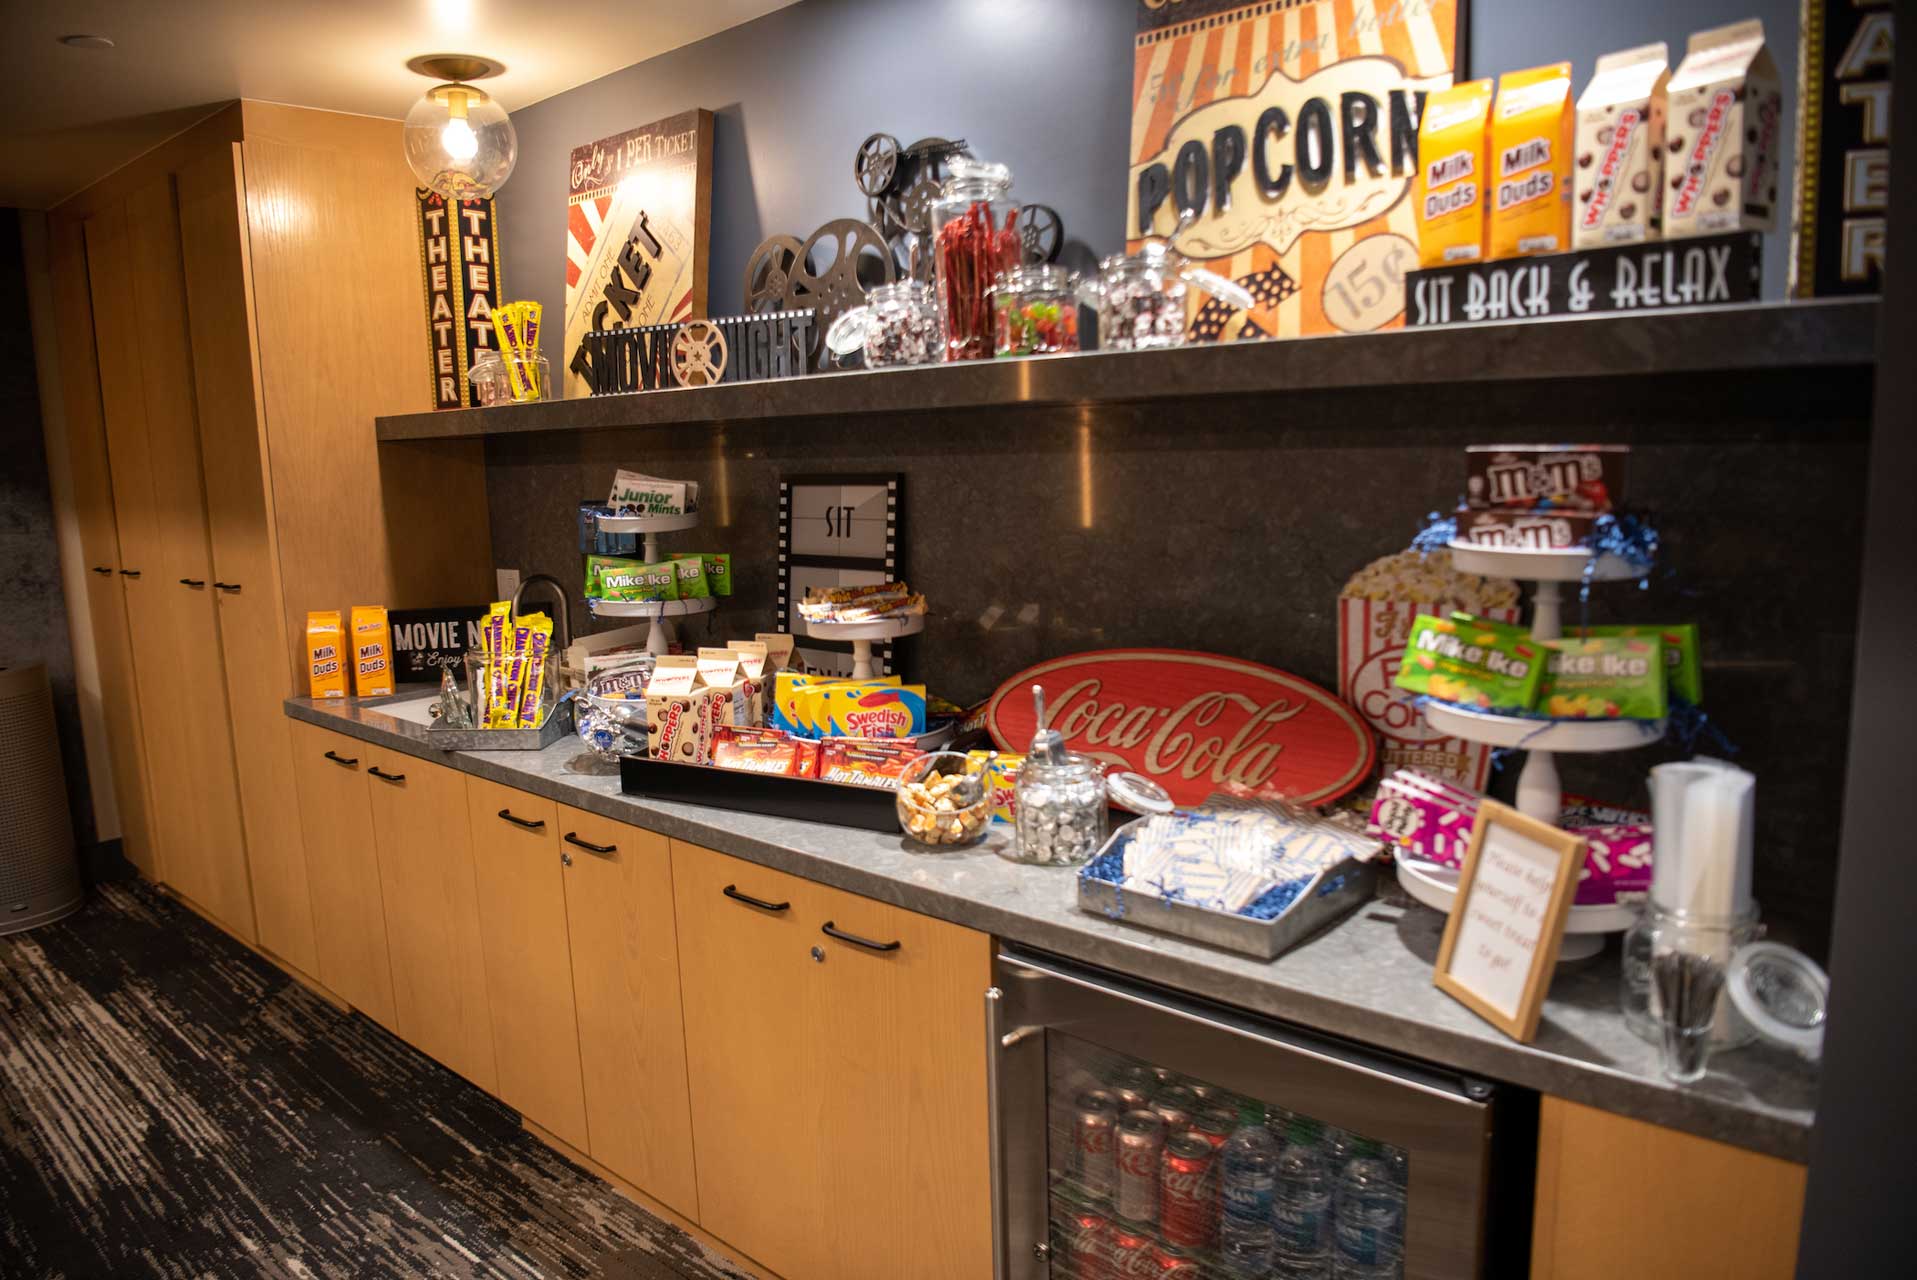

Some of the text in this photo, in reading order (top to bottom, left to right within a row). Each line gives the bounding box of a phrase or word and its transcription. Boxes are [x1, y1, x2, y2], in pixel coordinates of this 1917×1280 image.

[625, 134, 652, 169] PER
[654, 130, 697, 159] TICKET
[1138, 89, 1430, 234] POPCORN
[1503, 138, 1550, 176] Milk
[1674, 92, 1733, 214] WHOPPERS
[1429, 152, 1474, 188] Milk
[1583, 111, 1638, 226] WHOPPERS
[1425, 184, 1475, 218] Duds
[1499, 173, 1552, 208] Duds
[1415, 246, 1732, 326] SIT BACK & RELAX
[424, 208, 458, 402] THEATER
[618, 488, 673, 504] Junior
[648, 502, 681, 515] Mints
[826, 506, 855, 538] SIT
[605, 573, 671, 588] Mike Ike
[394, 620, 461, 651] MOVIE
[313, 646, 335, 661] Milk
[359, 644, 382, 659] Milk
[359, 659, 385, 674] Duds
[426, 651, 462, 668] Enjoy
[1416, 629, 1483, 663] Mike
[1486, 650, 1529, 678] Ike
[1600, 653, 1649, 676] Ike
[313, 661, 338, 676] Duds
[846, 708, 907, 731] Swedish
[829, 767, 849, 783] HOT
